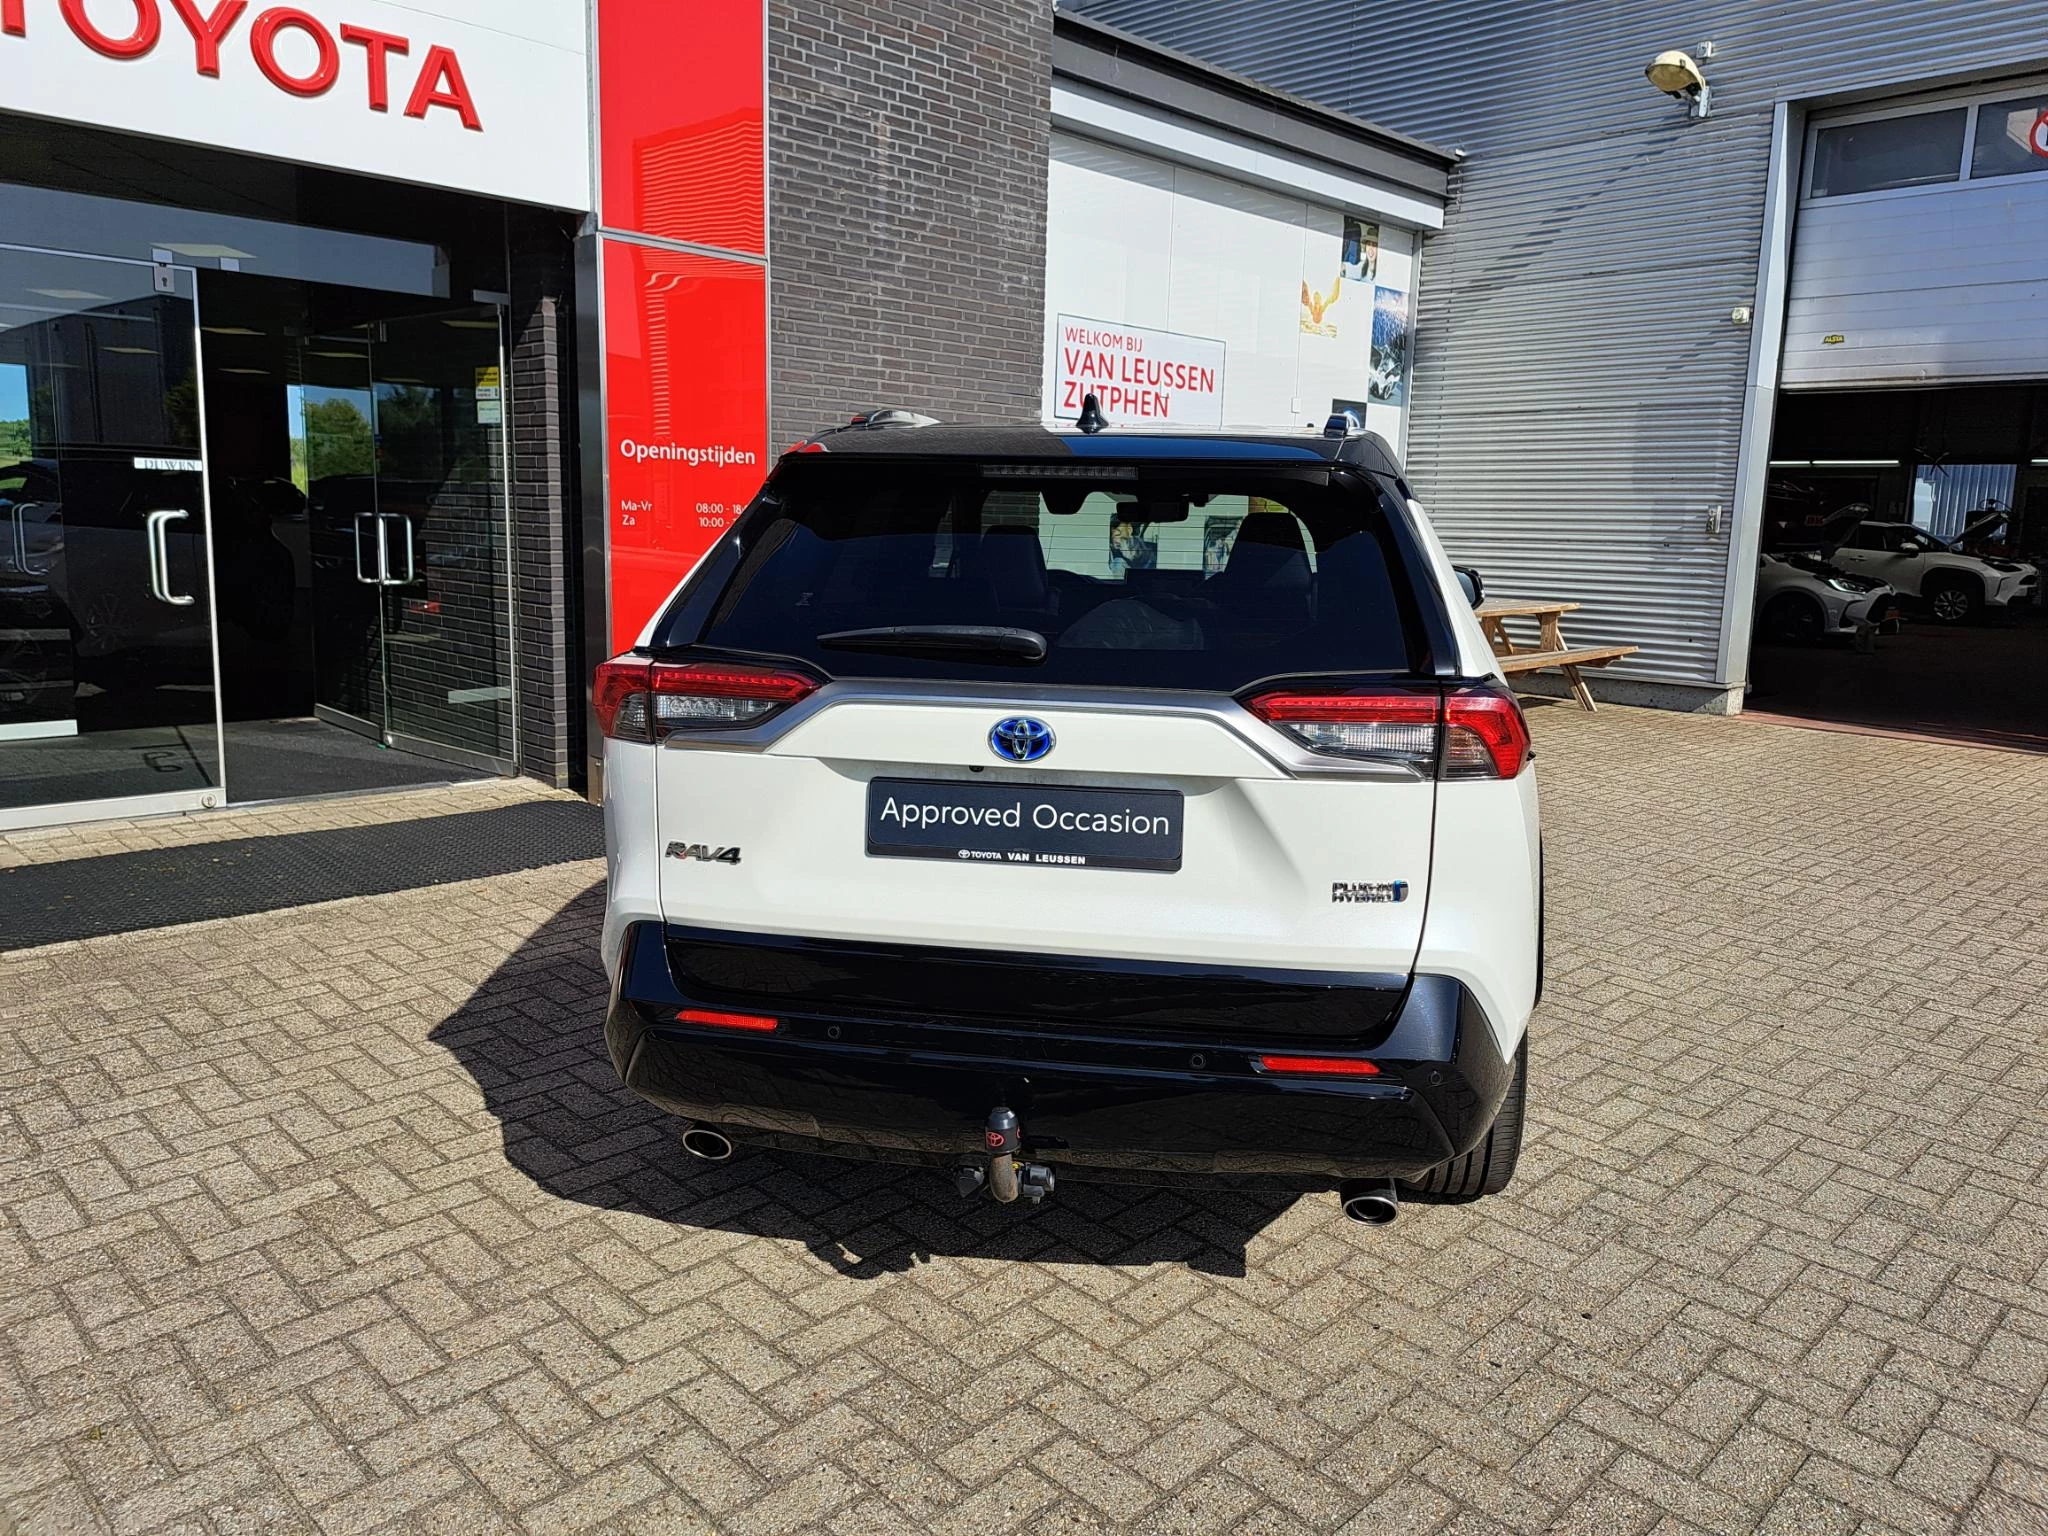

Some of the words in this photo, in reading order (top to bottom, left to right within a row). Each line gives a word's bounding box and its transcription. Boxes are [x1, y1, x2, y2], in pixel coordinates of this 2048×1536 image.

[1065, 326, 1123, 349] WELKOM
[1126, 336, 1143, 352] BIJ
[1064, 347, 1114, 380] VAN
[1121, 355, 1214, 393] LEUSSEN
[620, 439, 756, 468] Openingstijden
[621, 500, 652, 511] Ma-Vr
[695, 502, 724, 514] 08:00
[622, 514, 635, 526] Za
[699, 516, 724, 528] 10:00
[880, 796, 1021, 829] Approved
[1032, 804, 1169, 835] Occasion
[665, 841, 741, 865] RAV4
[970, 850, 1002, 860] TOYOTA
[1007, 852, 1030, 861] VAN
[1035, 854, 1086, 865] LEUSSEN
